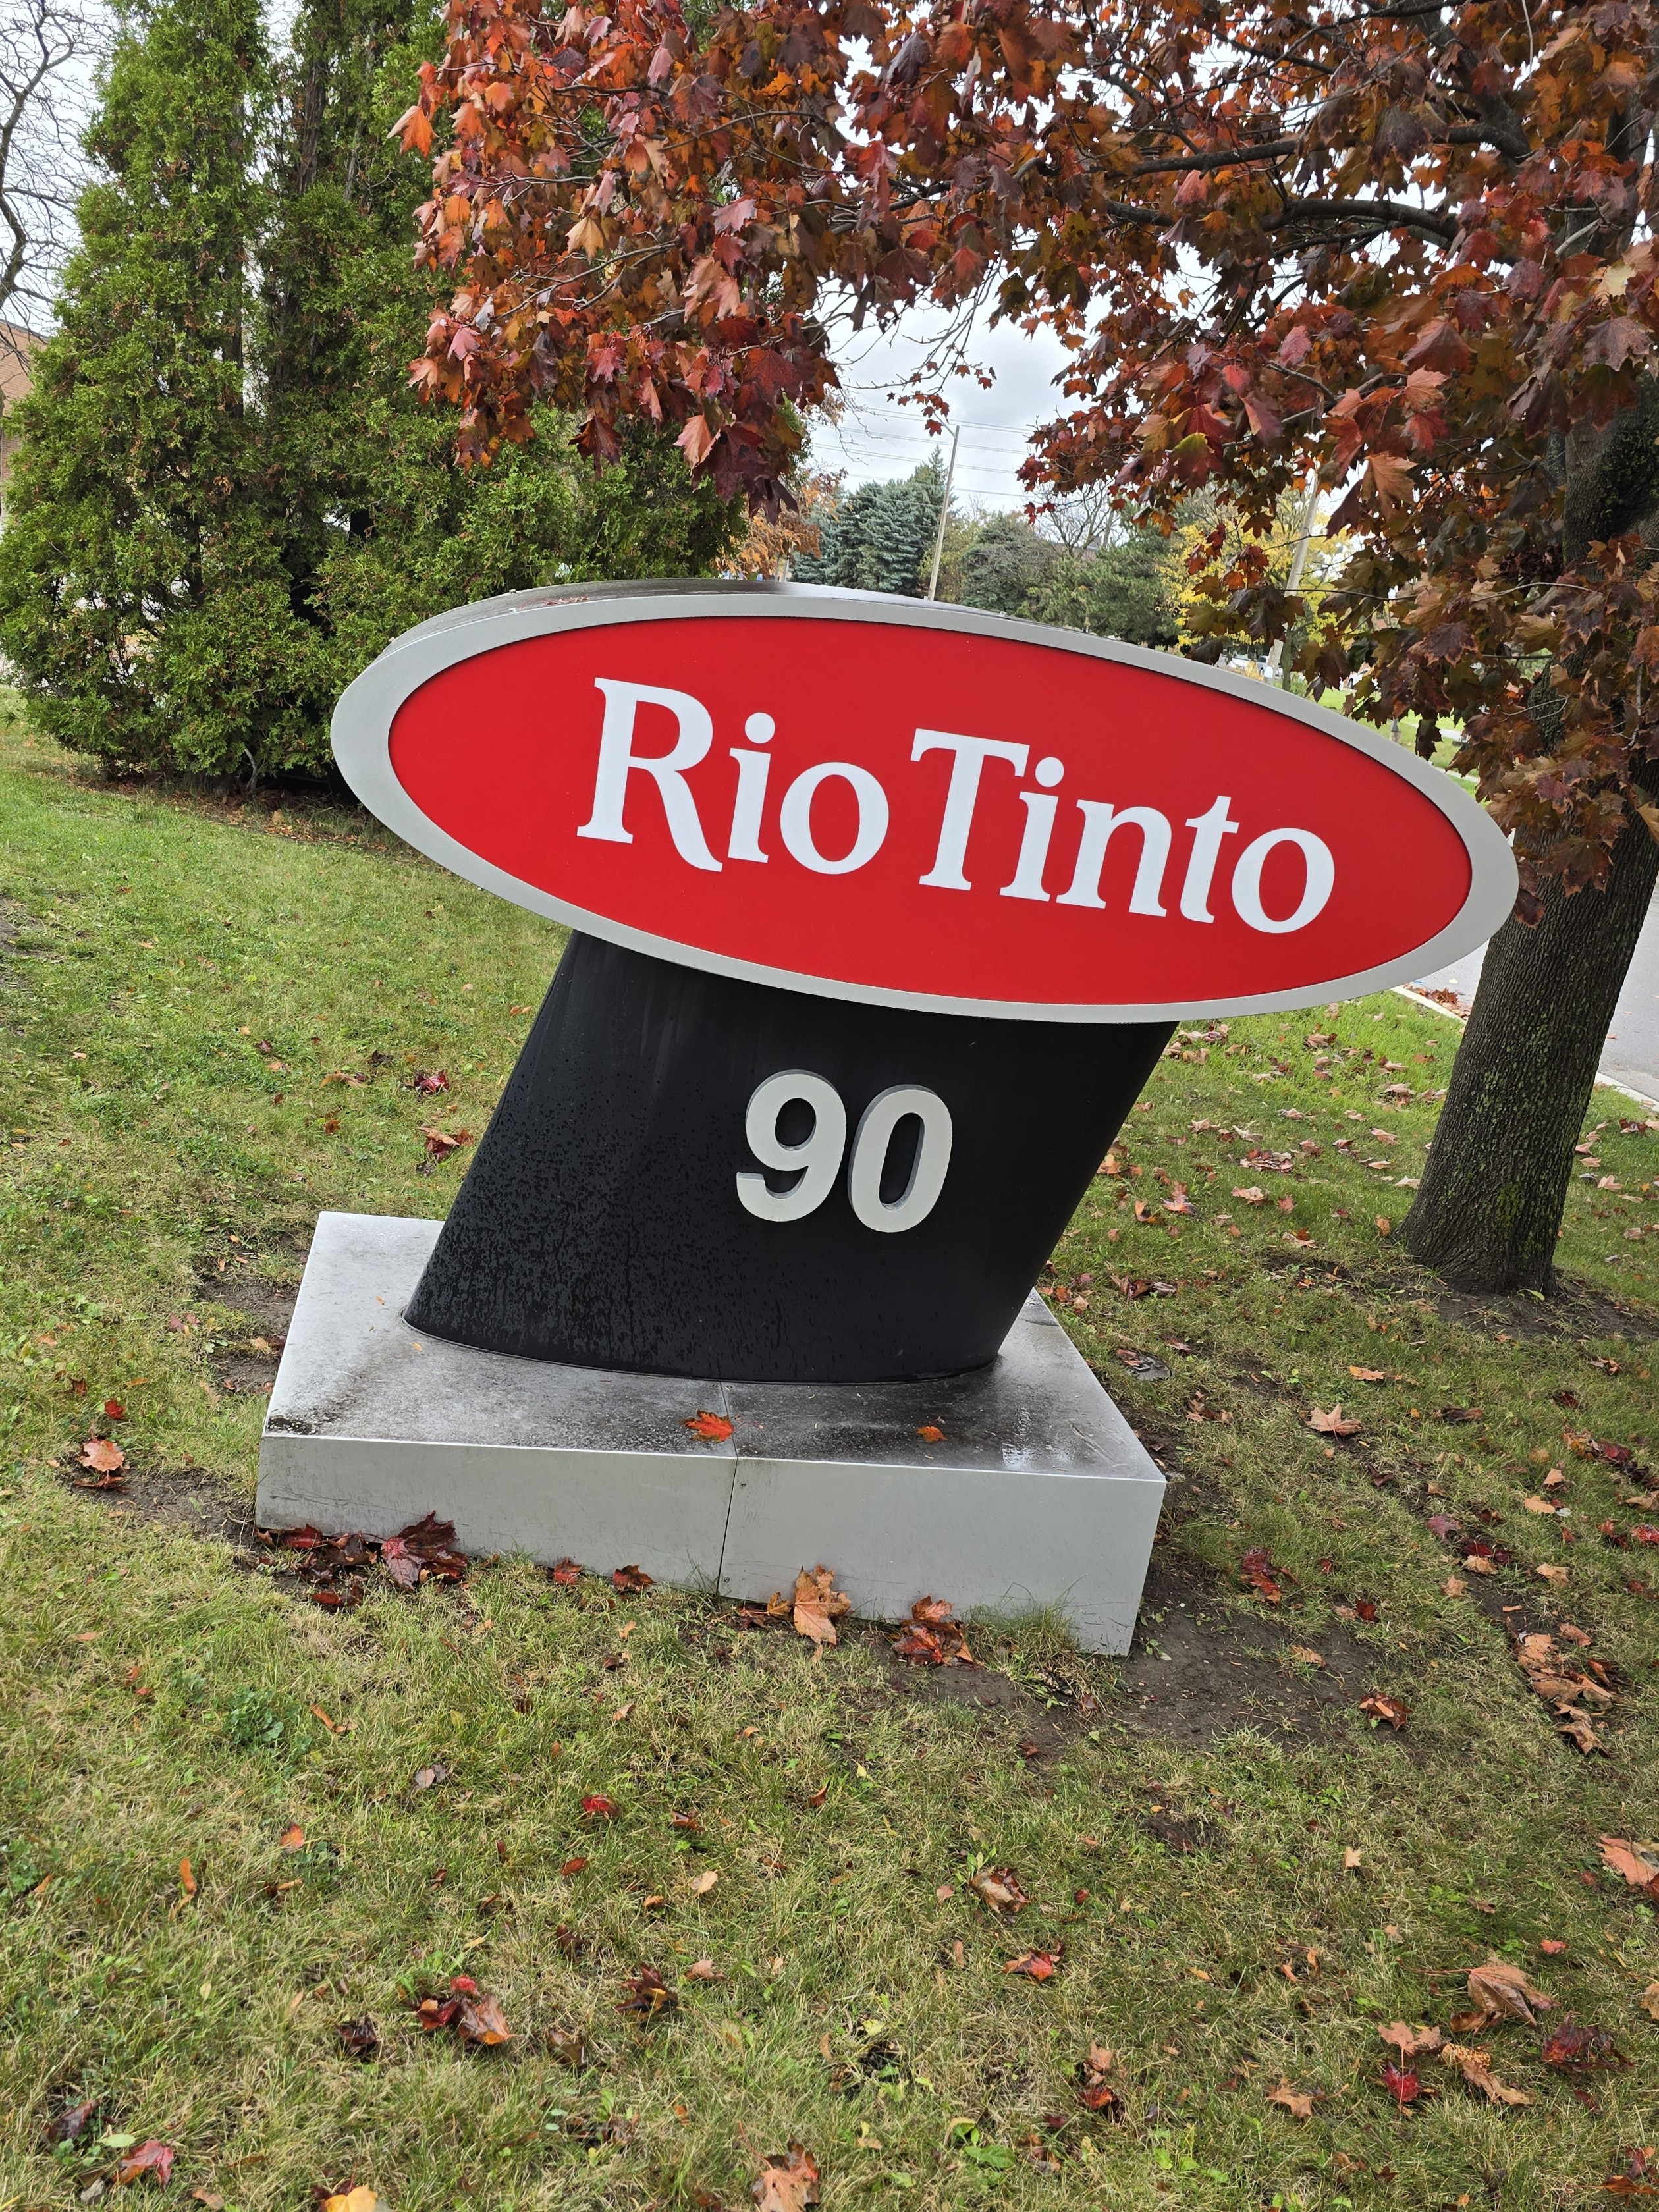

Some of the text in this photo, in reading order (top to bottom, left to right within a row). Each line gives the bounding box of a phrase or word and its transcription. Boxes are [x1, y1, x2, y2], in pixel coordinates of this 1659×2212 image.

[576, 677, 1336, 934] Rio Tinto
[735, 1069, 954, 1234] 90
